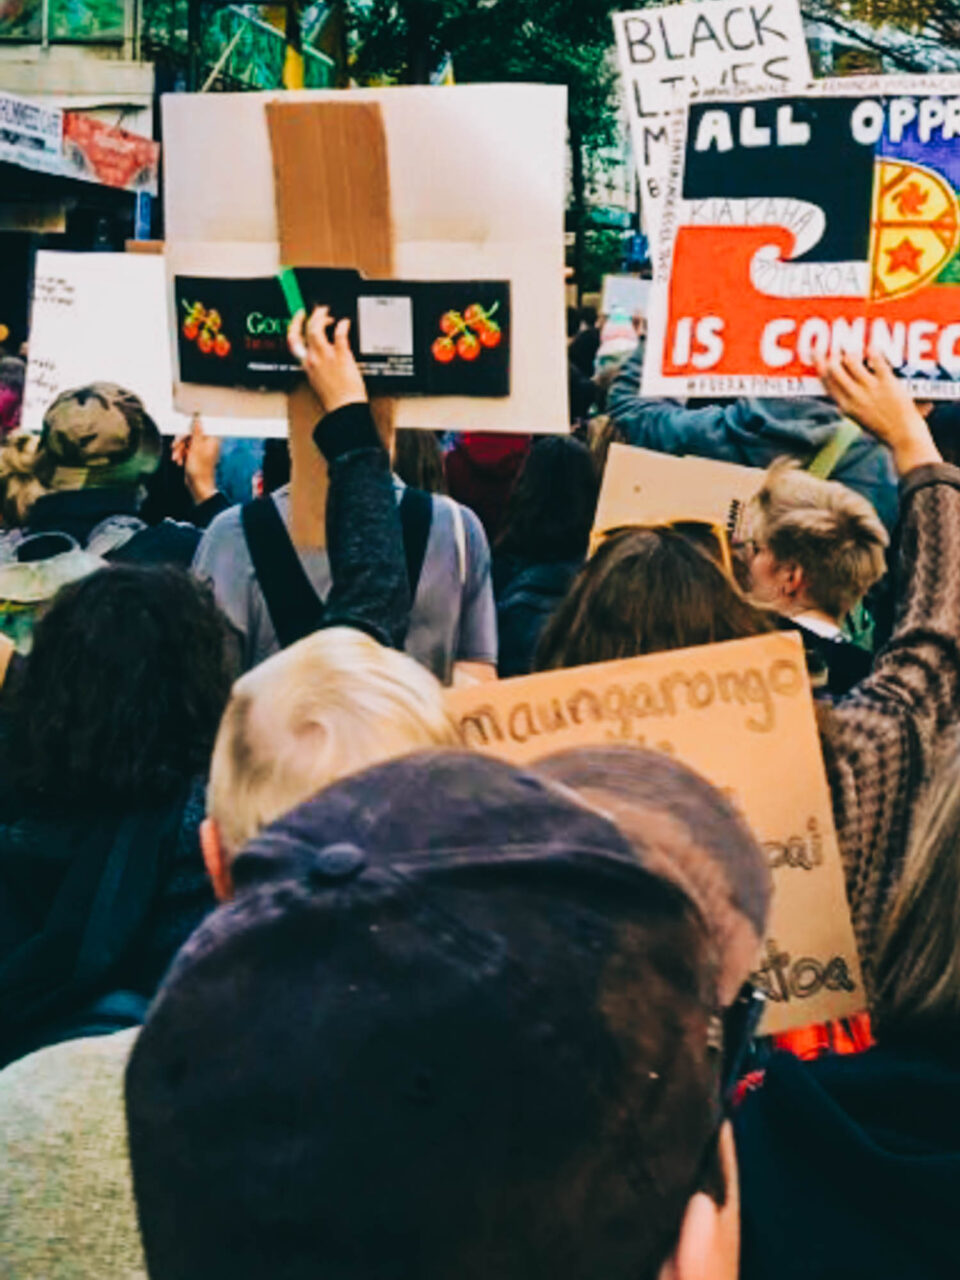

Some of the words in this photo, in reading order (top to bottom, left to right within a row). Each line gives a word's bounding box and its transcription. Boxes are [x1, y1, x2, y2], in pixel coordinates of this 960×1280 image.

[623, 4, 789, 64] BLACK
[693, 102, 811, 153] ALL
[690, 198, 734, 226] KIA
[671, 315, 725, 370] IS
[454, 658, 800, 740] maungarongo
